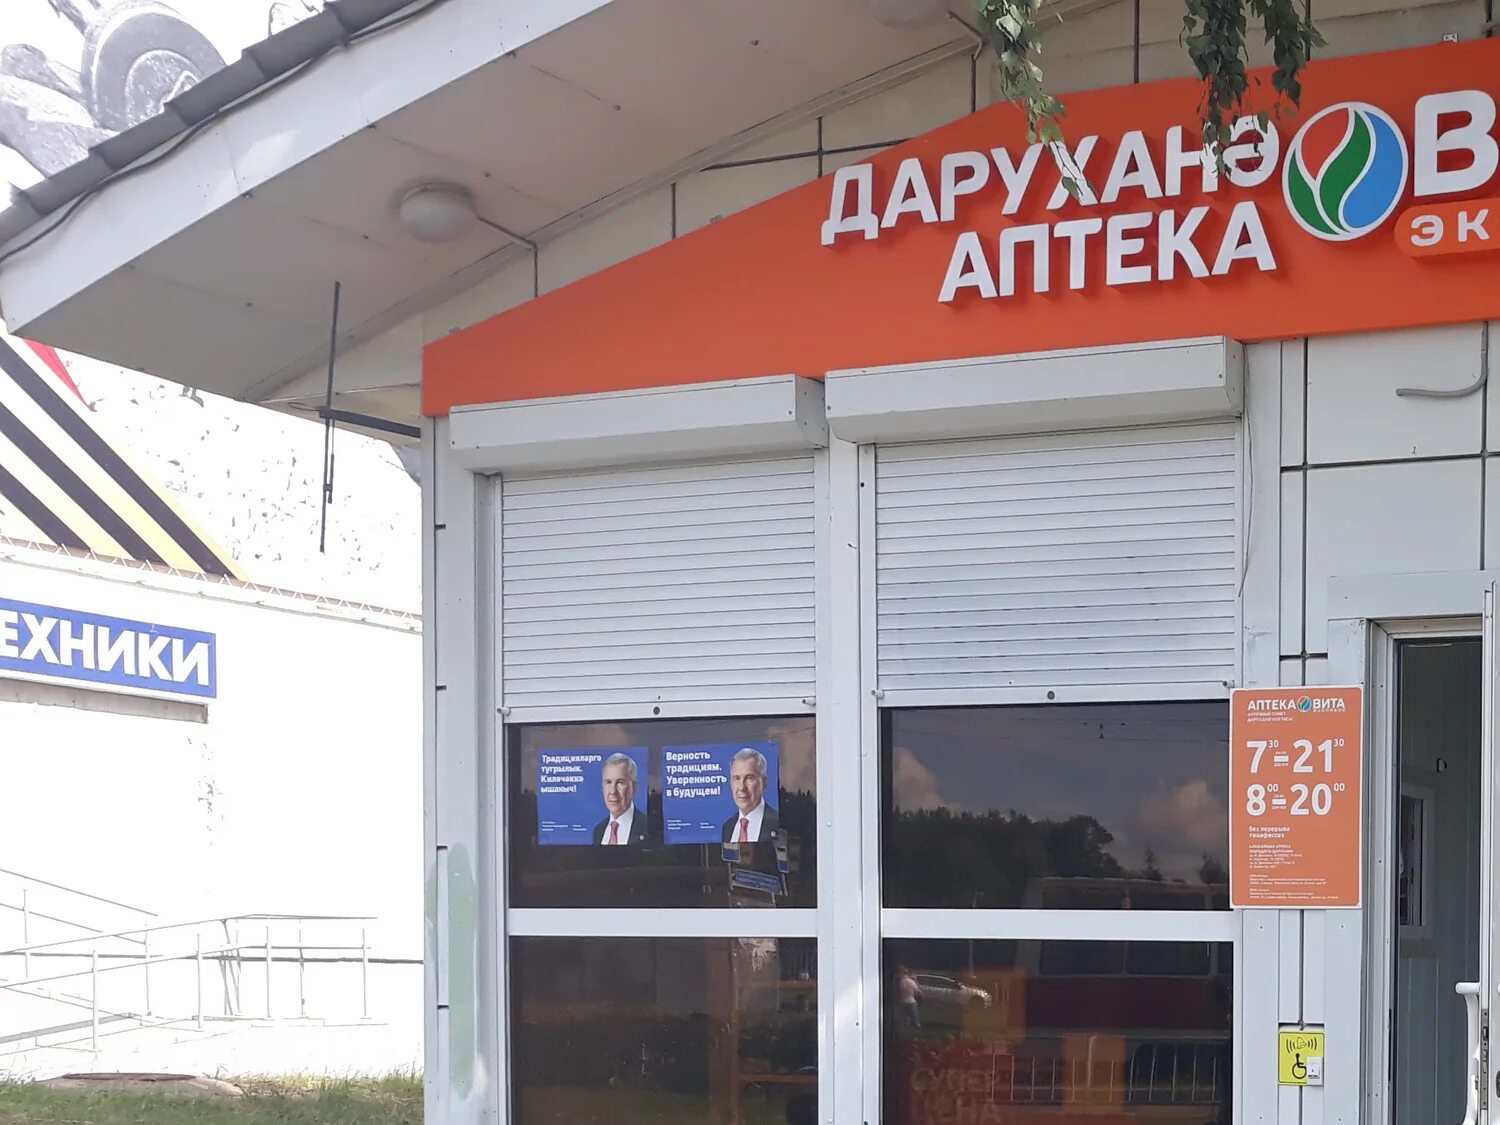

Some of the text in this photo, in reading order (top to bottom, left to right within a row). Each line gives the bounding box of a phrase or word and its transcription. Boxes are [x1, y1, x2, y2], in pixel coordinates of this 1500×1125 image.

[820, 114, 1280, 246] ДАРУХАНӘ
[938, 201, 1276, 302] АПТЕКА
[1247, 698, 1345, 711] АПТЕКА ВИТА
[666, 751, 710, 762] Верность
[666, 763, 722, 774] традициям.
[666, 775, 727, 786] Уверенность
[673, 785, 721, 798] будущем!
